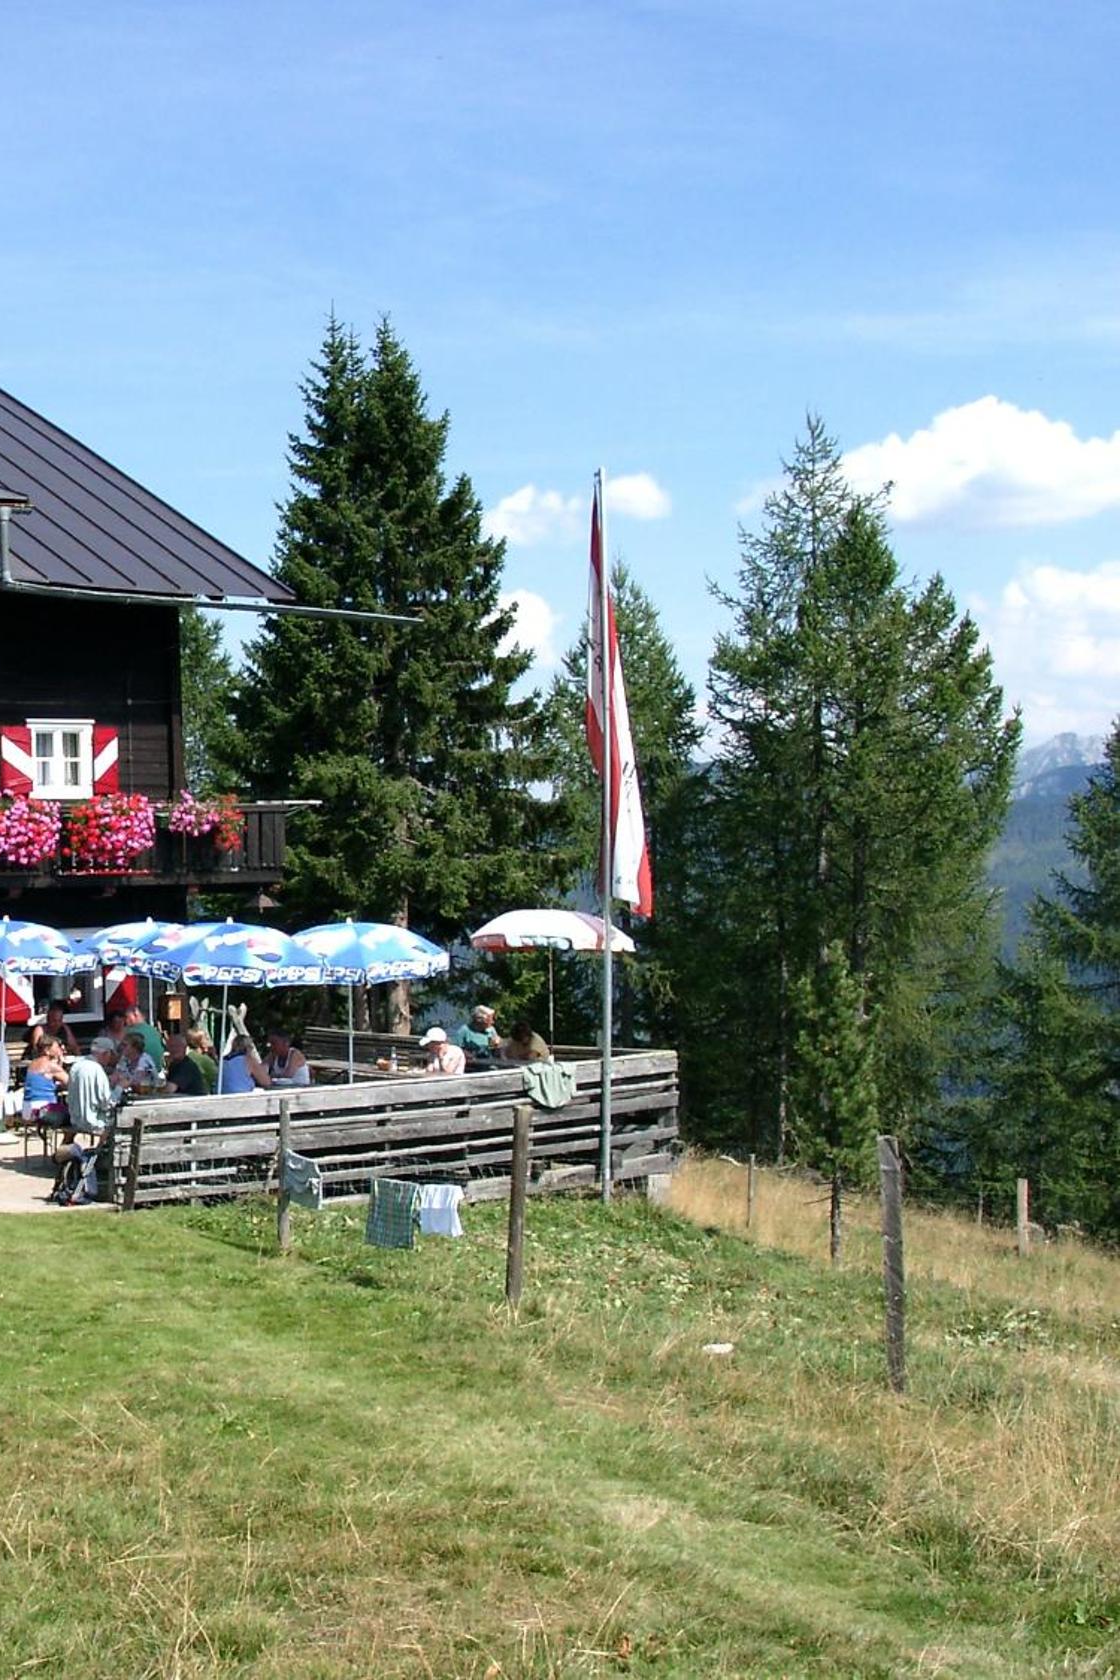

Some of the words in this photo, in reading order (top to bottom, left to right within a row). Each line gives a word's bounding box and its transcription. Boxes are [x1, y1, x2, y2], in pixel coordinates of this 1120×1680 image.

[204, 964, 262, 984] PEPSI
[277, 965, 321, 982] PEPSI
[323, 966, 365, 983] EPSI
